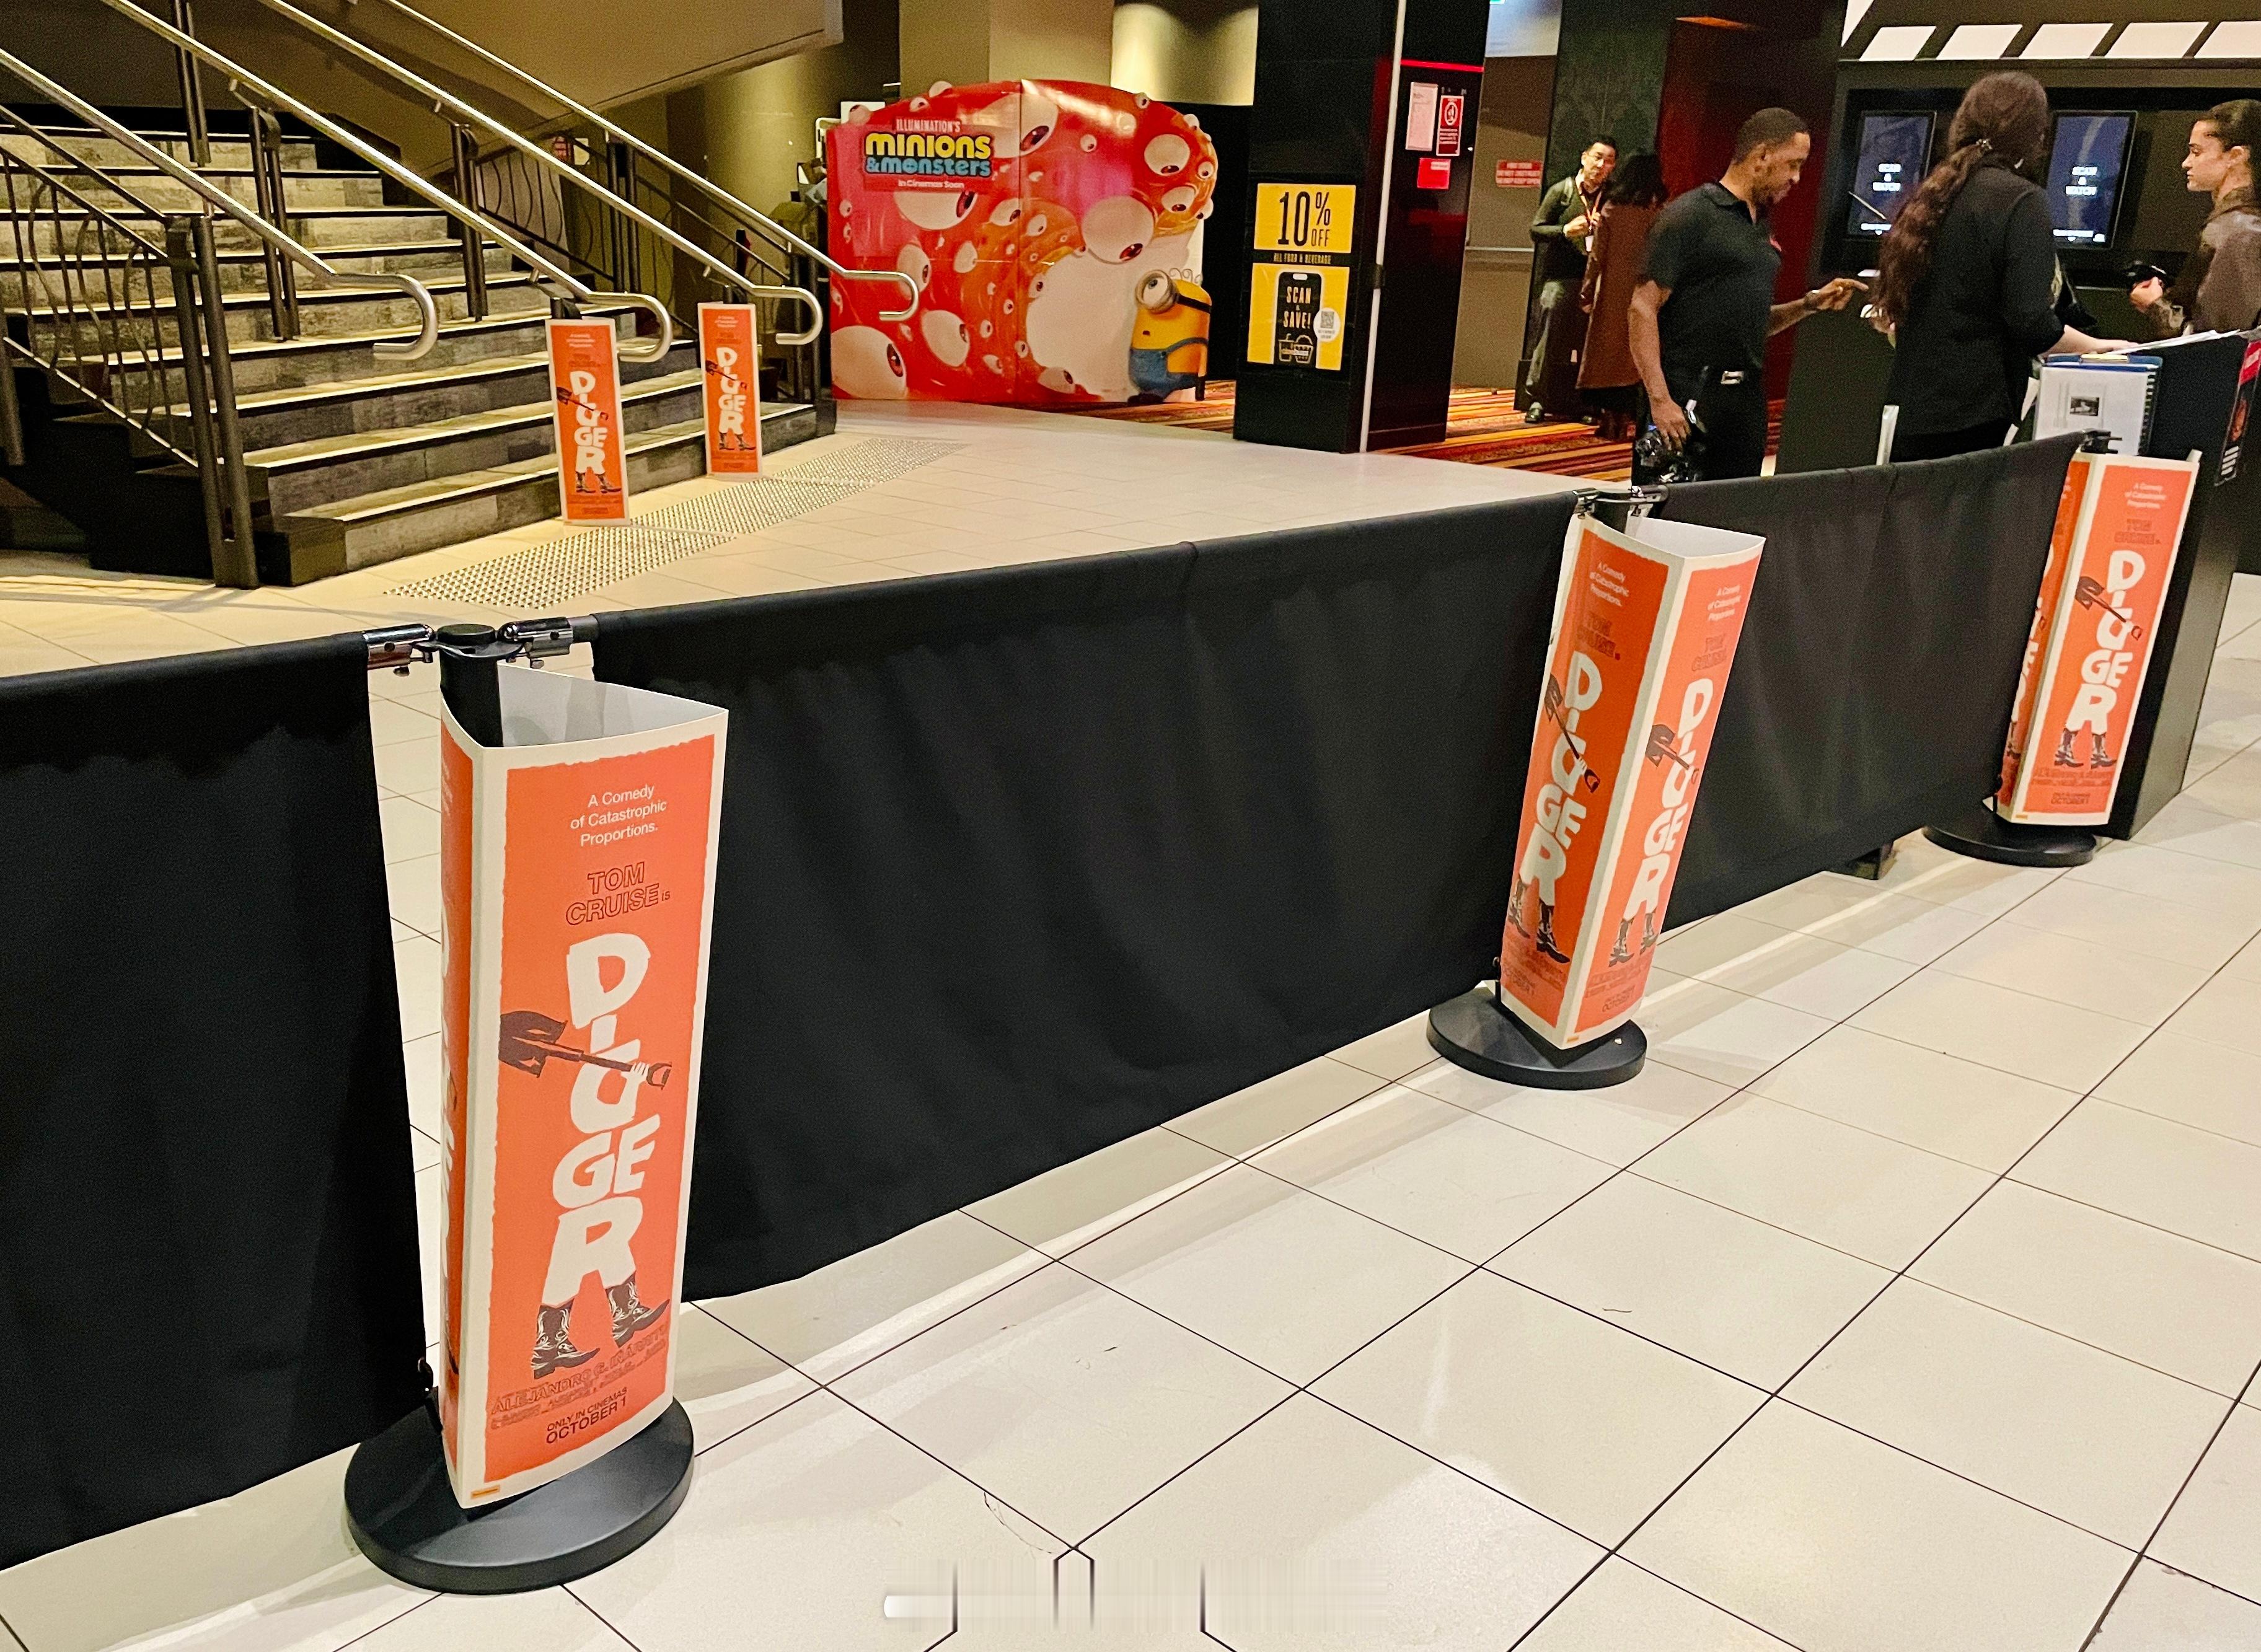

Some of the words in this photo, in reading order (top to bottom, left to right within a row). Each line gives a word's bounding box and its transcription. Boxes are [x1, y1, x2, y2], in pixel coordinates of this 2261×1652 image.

[896, 118, 961, 133] ILLUMINATION'S
[1311, 228, 1331, 247] OFF
[1286, 286, 1311, 304] SCAN
[1283, 310, 1311, 329] SAVE!
[588, 794, 598, 807] A
[602, 783, 654, 805] Comedy
[570, 815, 585, 829] of
[588, 799, 668, 827] Catastrophic
[580, 822, 658, 846] Proportions.
[587, 861, 645, 895] TOM
[566, 883, 659, 926] CRUISE
[491, 1369, 591, 1415] ALEJANDRO
[546, 1404, 618, 1444] OCTOBER
[620, 1397, 627, 1411] 1
[547, 1413, 573, 1431] ONLY
[576, 1408, 586, 1422] IN
[587, 1387, 627, 1414] CINEMAS
